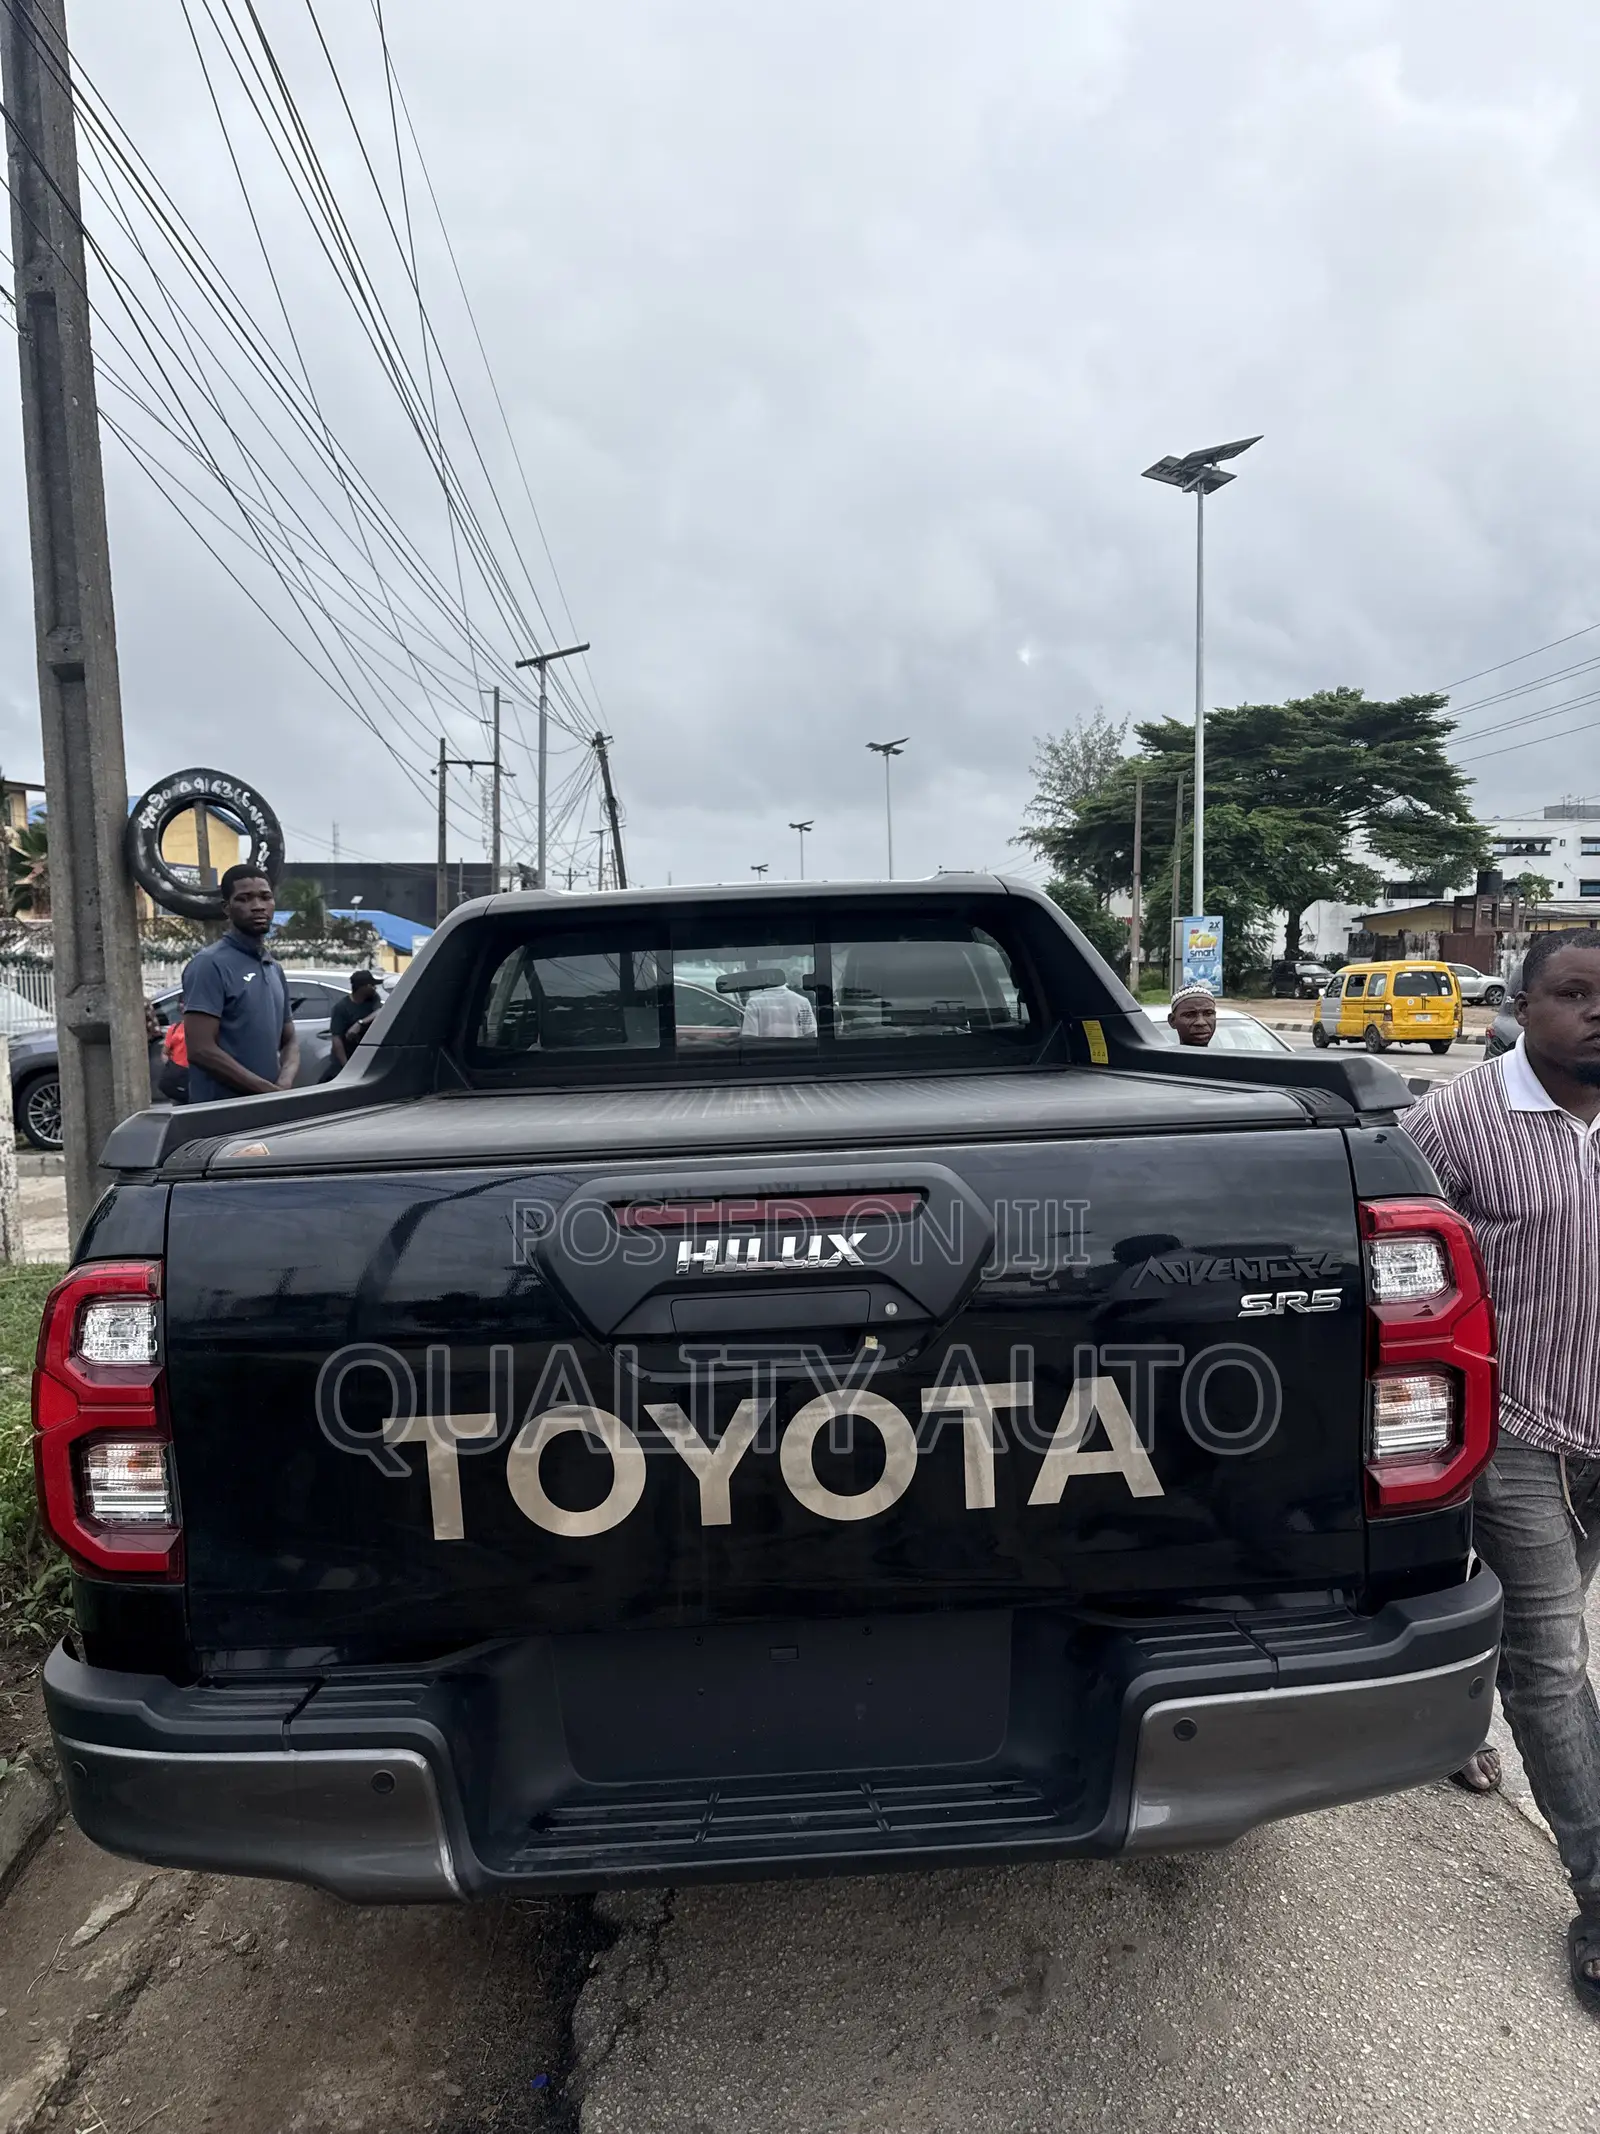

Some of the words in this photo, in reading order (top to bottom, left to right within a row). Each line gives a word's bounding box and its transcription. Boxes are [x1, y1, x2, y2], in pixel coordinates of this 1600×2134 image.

[1190, 949, 1215, 957] smart
[675, 1232, 868, 1275] HILUX
[1132, 1251, 1345, 1291] ADVENTURE
[1237, 1288, 1344, 1318] SR5
[382, 1375, 1166, 1542] TOYOTA
